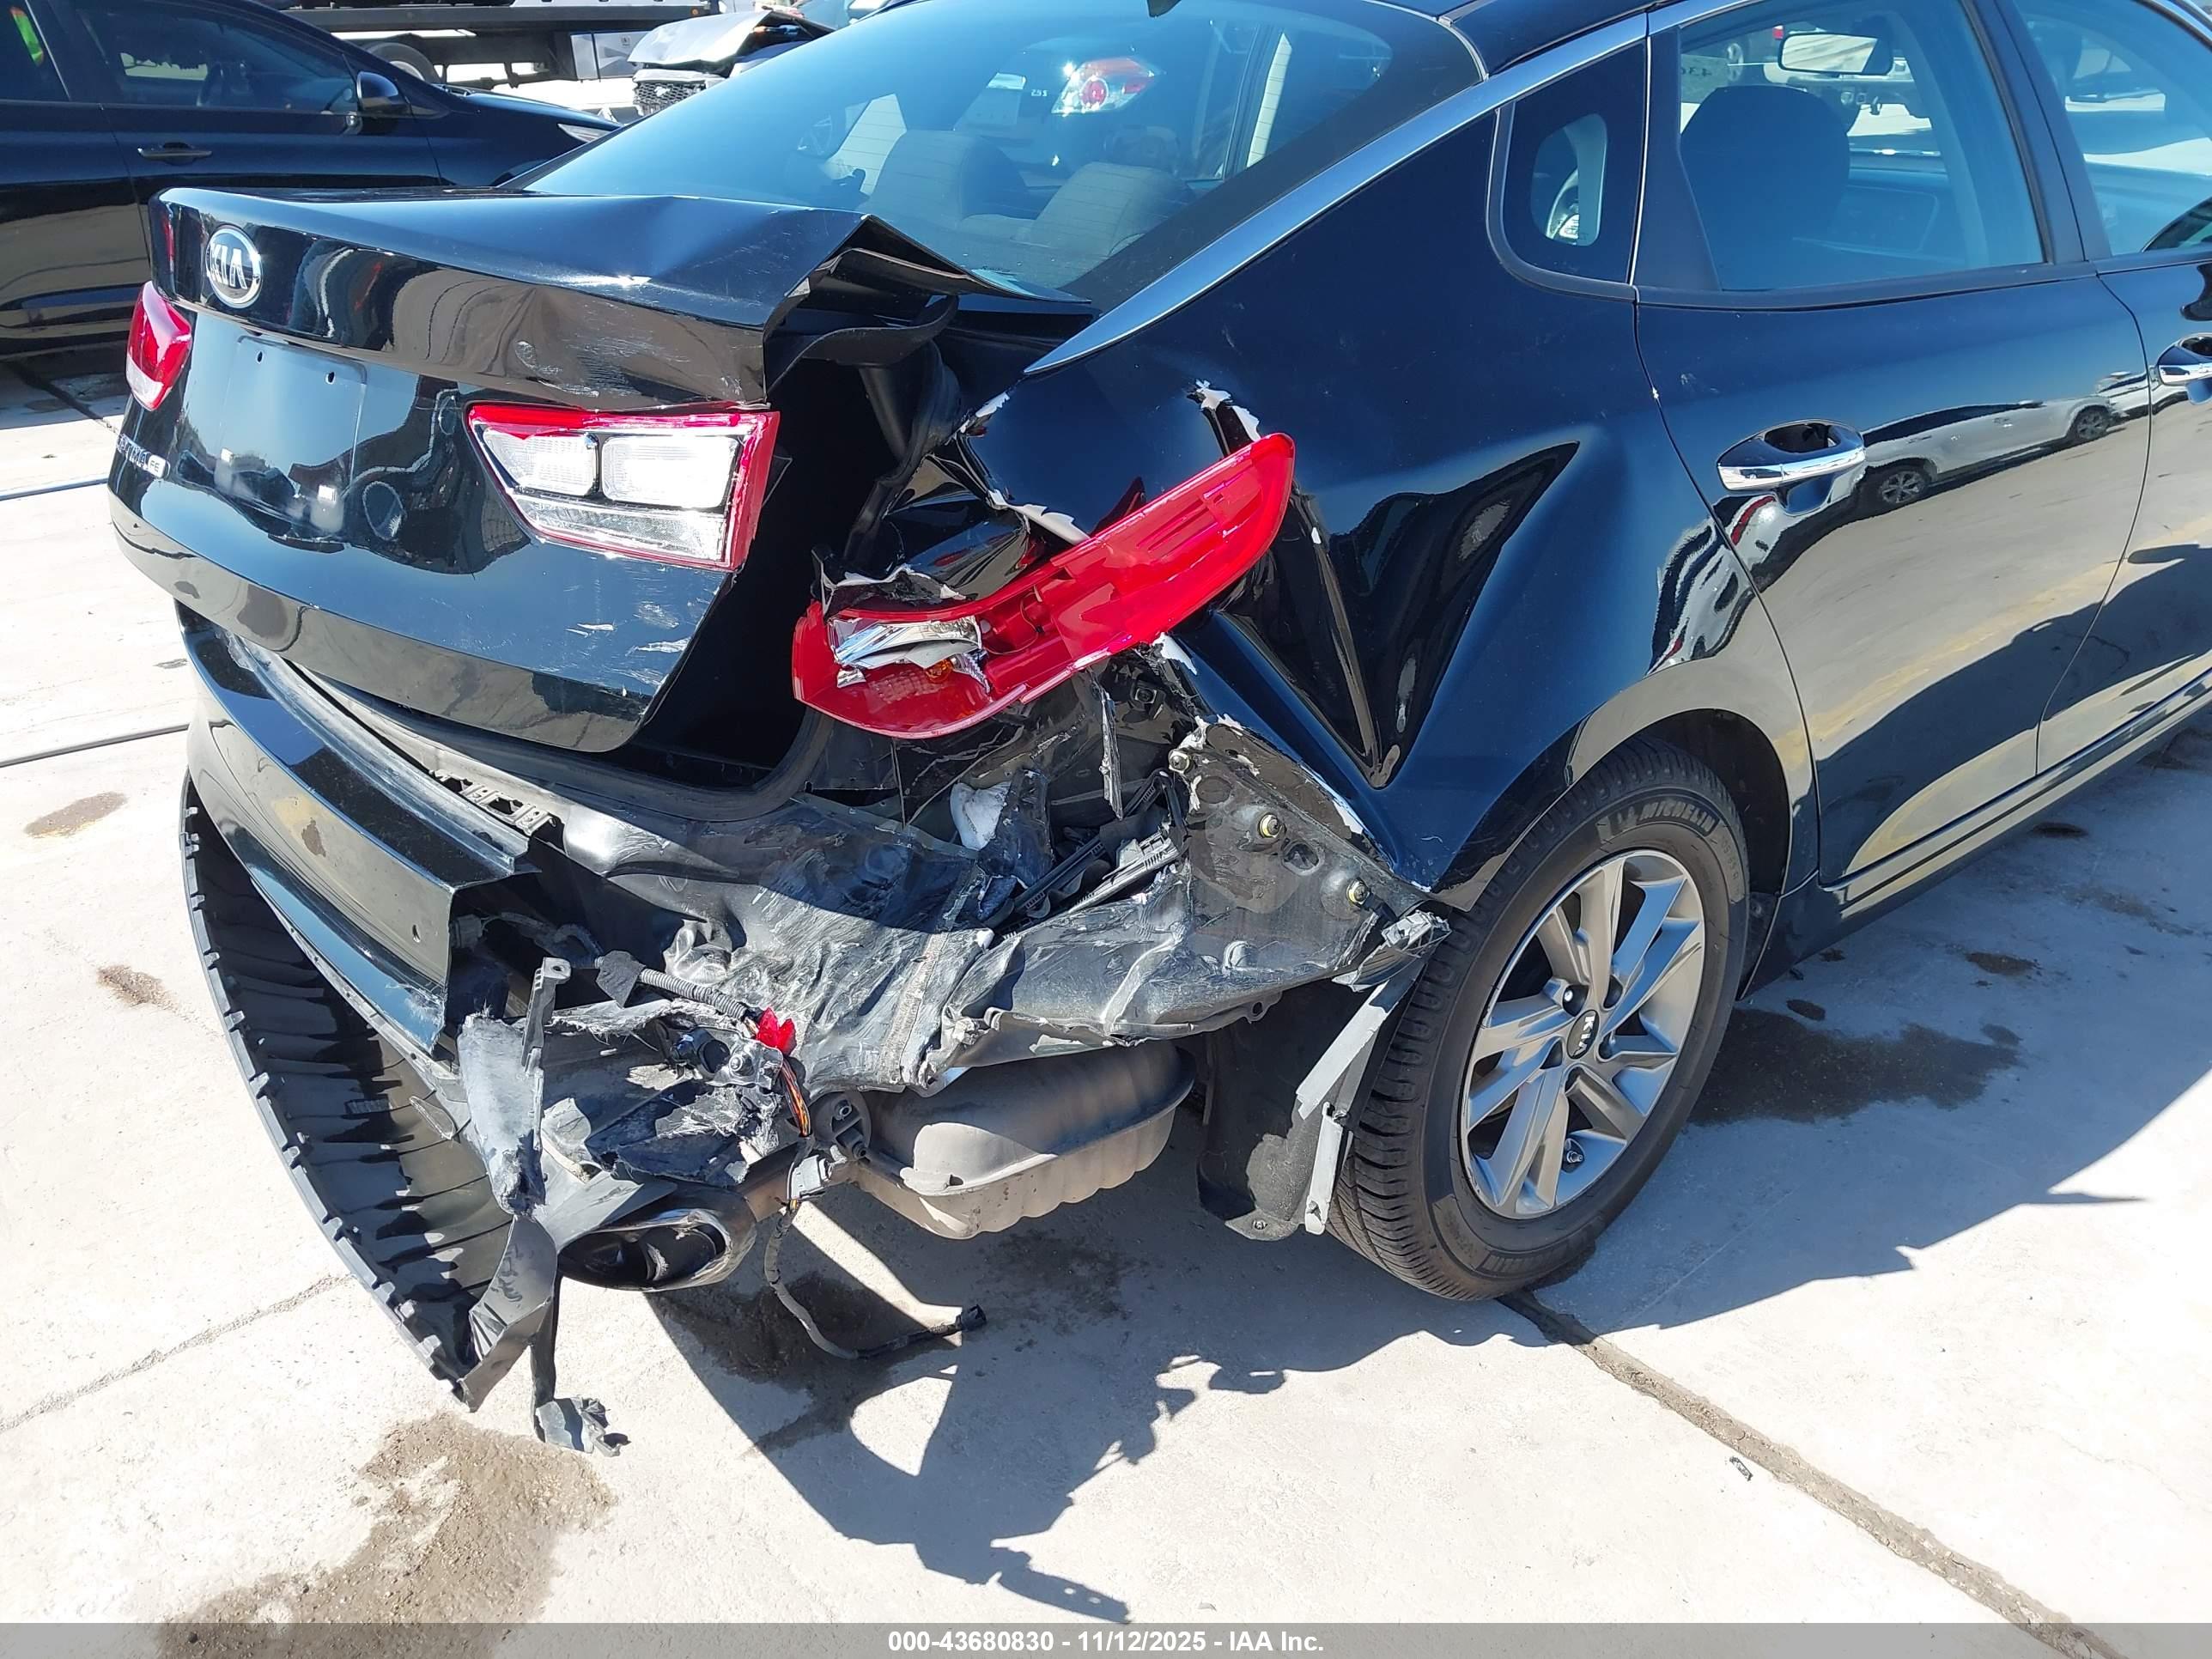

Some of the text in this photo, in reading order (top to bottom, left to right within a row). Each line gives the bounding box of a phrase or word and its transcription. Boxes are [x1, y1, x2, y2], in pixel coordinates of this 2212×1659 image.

[210, 243, 248, 290] KIA
[1638, 799, 1716, 833] MICHELIN
[1574, 1015, 1596, 1056] KIA
